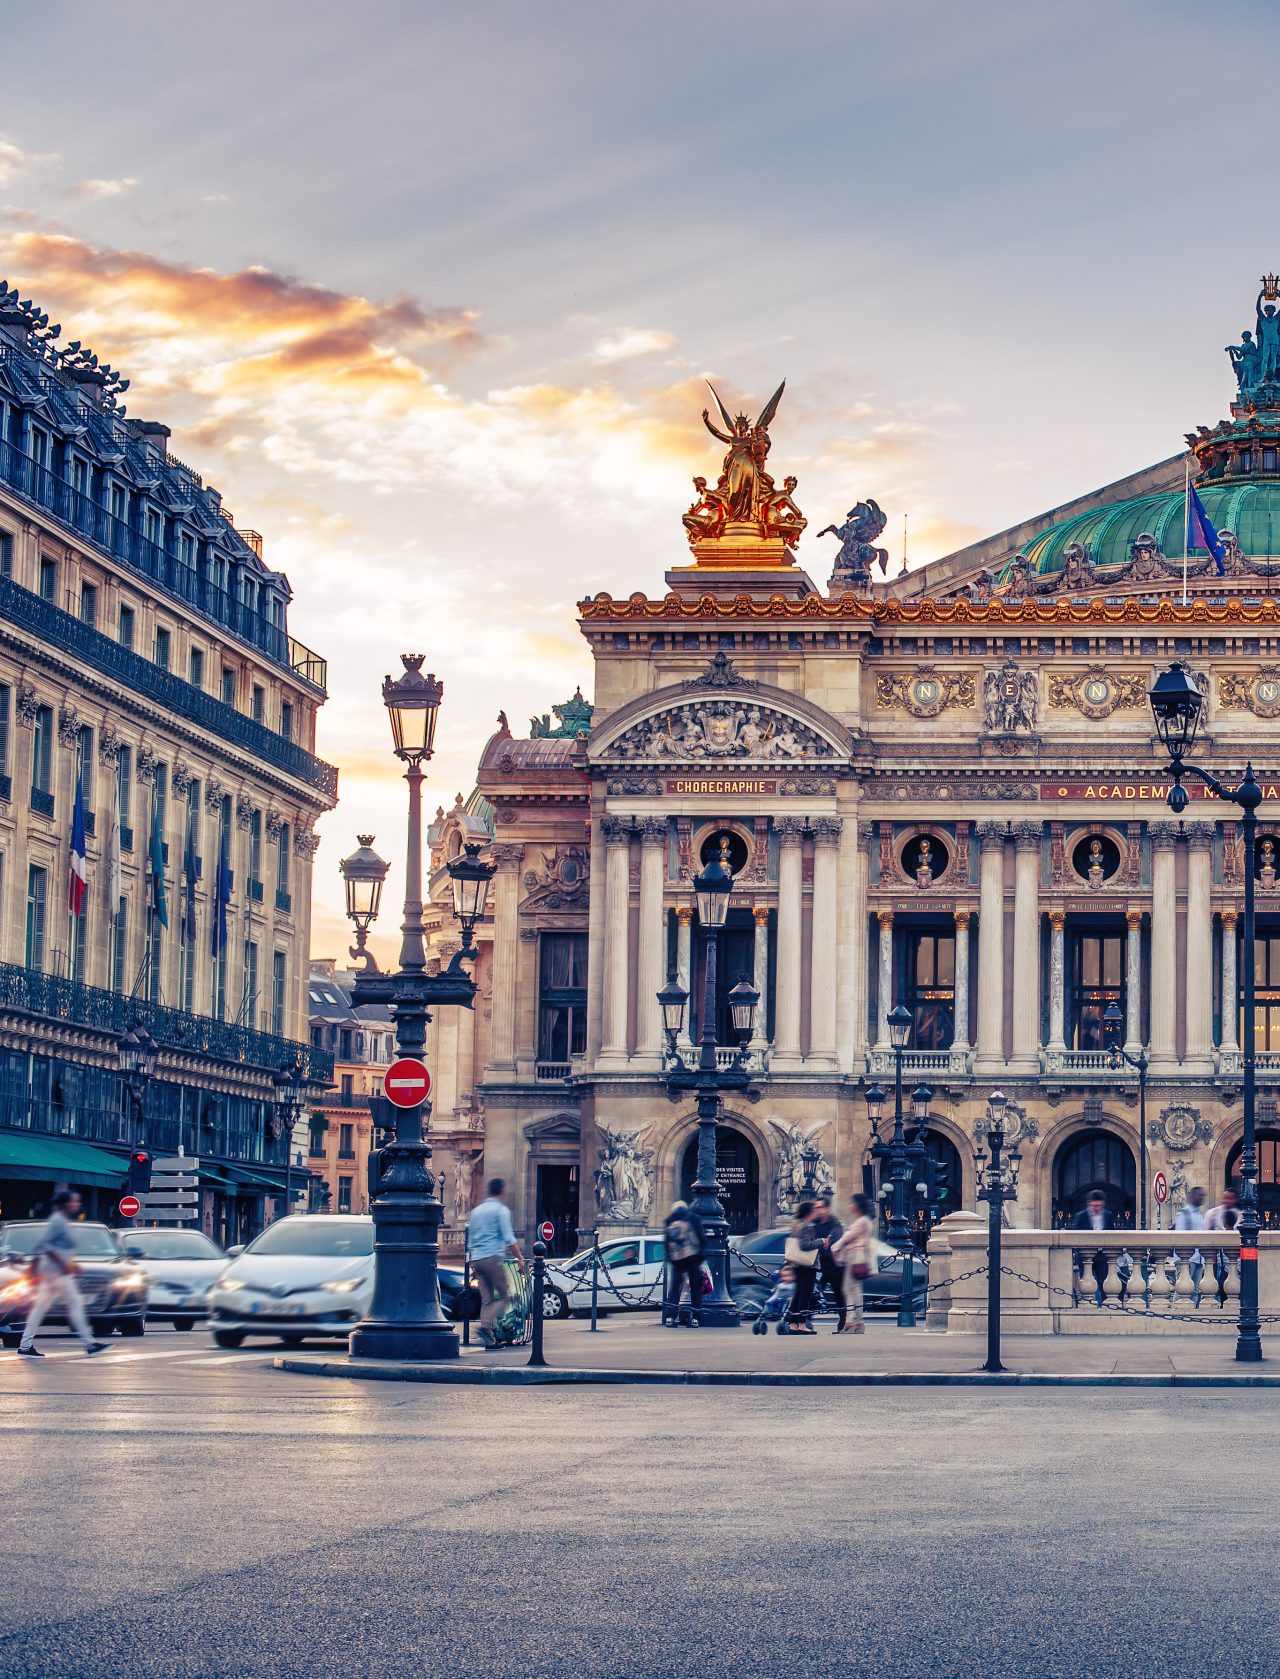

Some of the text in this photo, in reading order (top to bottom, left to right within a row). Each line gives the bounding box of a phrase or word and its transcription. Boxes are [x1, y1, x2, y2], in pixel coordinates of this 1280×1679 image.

[920, 685, 932, 698] N
[1006, 685, 1014, 696] E
[1092, 685, 1103, 697] N
[1263, 685, 1275, 697] N
[676, 781, 766, 793] CHOREGRAPHIE
